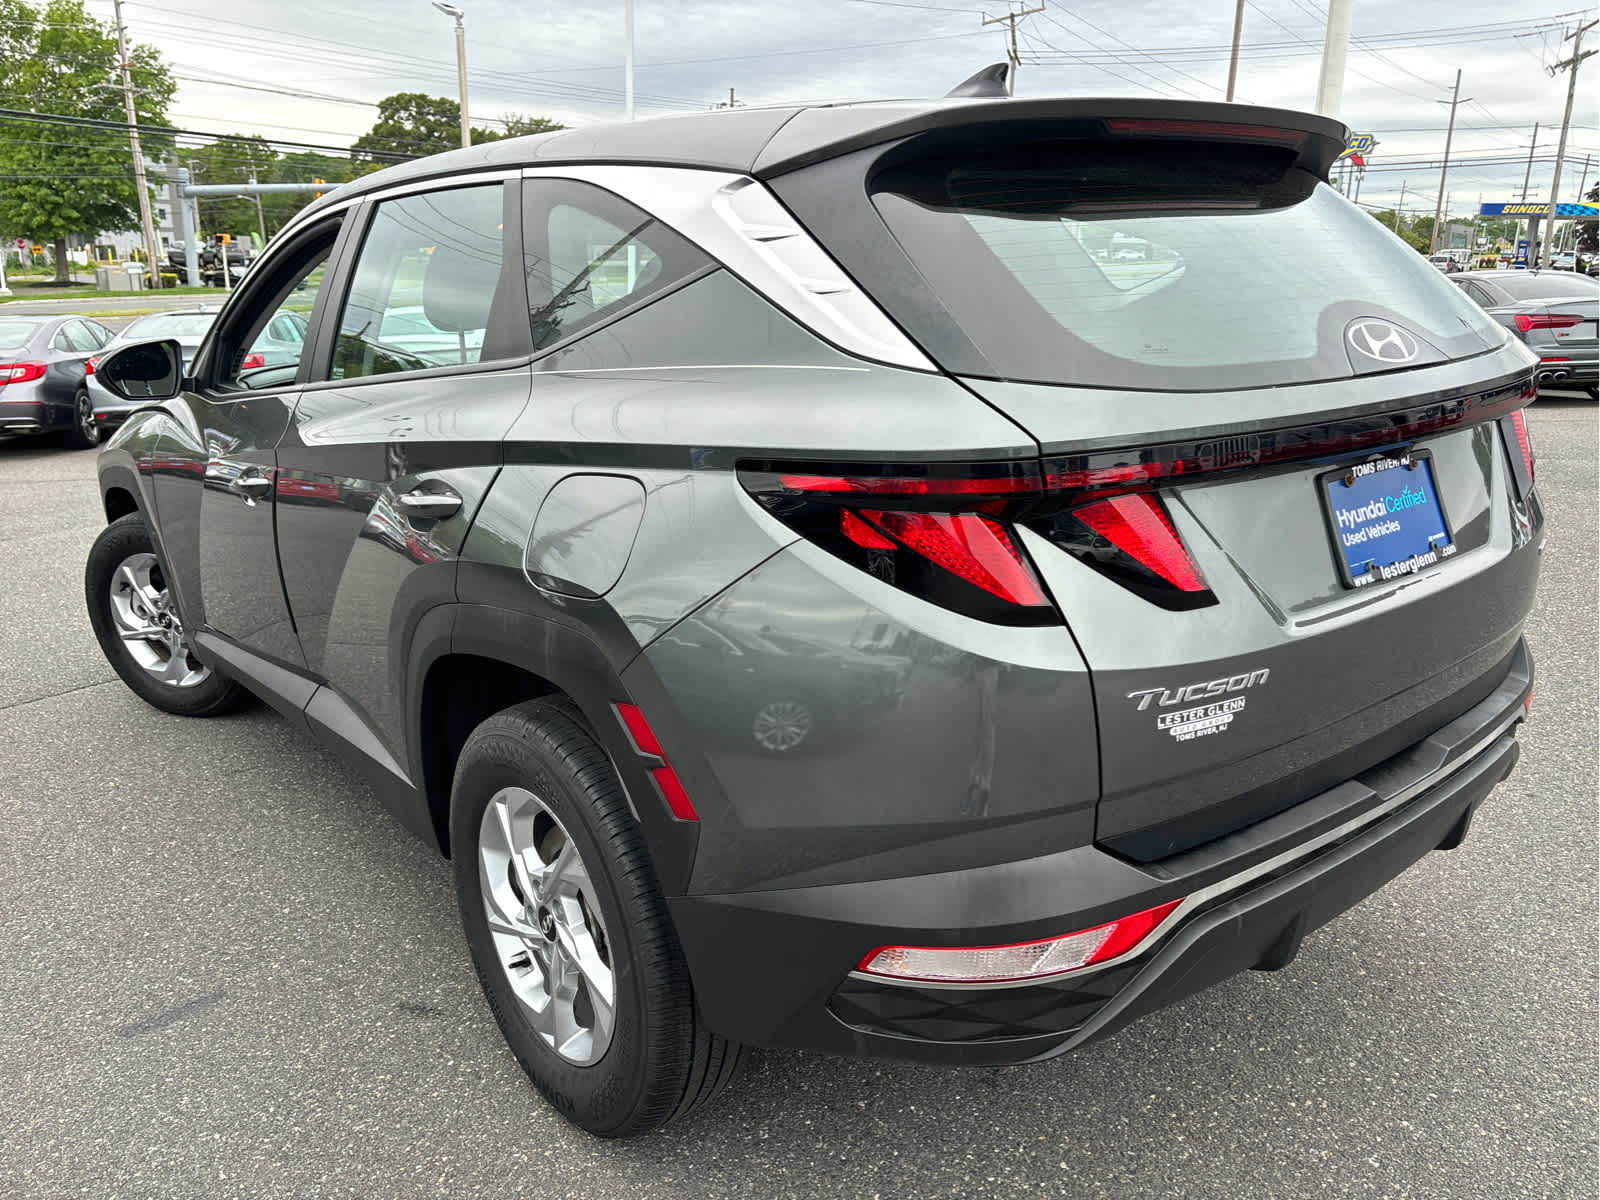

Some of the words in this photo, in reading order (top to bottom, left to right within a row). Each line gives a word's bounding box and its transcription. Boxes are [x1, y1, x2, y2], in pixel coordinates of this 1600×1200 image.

[1352, 463, 1375, 478] TOMS
[1336, 498, 1387, 529] Hyundai
[1385, 486, 1427, 513] Certified
[1342, 529, 1367, 547] Used
[1366, 520, 1401, 540] Vehicles
[1380, 550, 1438, 580] lesterglenn
[1127, 668, 1270, 711] TUCSON
[1157, 709, 1205, 728] LESTER
[1208, 698, 1246, 716] GLENN
[1175, 730, 1196, 742] TOMS
[1197, 725, 1219, 738] RIVER,
[1219, 723, 1228, 732] NJ
